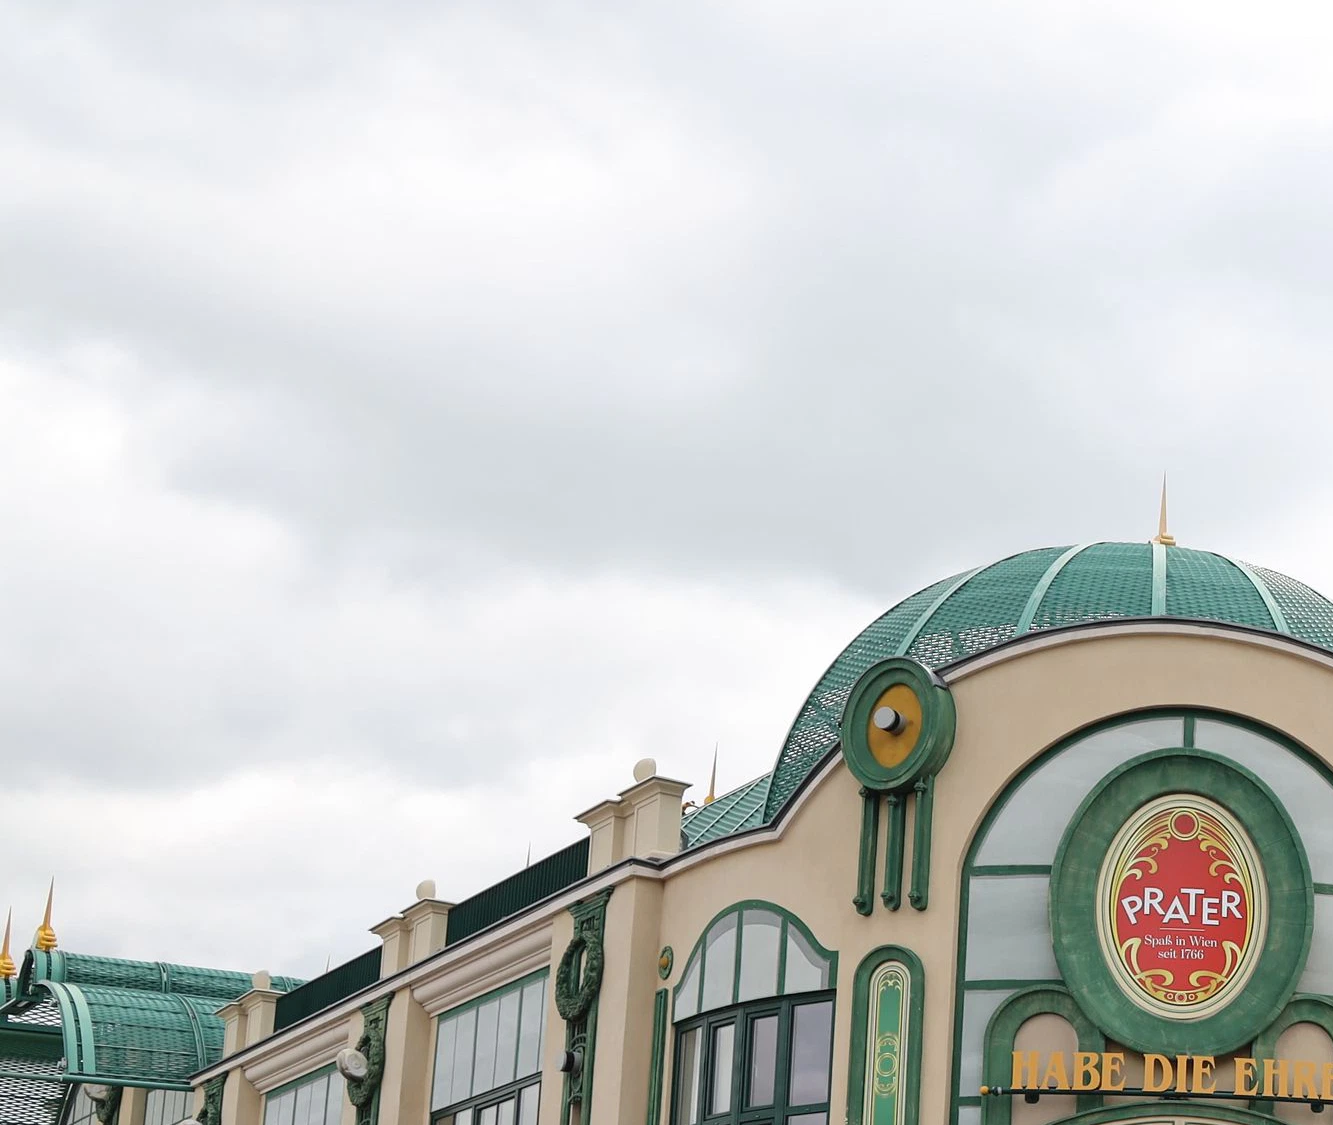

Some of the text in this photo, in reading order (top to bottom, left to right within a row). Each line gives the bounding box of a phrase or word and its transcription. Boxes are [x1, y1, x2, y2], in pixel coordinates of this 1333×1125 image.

[1121, 887, 1243, 926] PRATER
[1144, 934, 1217, 948] Spaß in Wien
[1158, 949, 1204, 960] seit 1766
[1011, 1051, 1126, 1091] HABE
[1141, 1053, 1217, 1094] DIE
